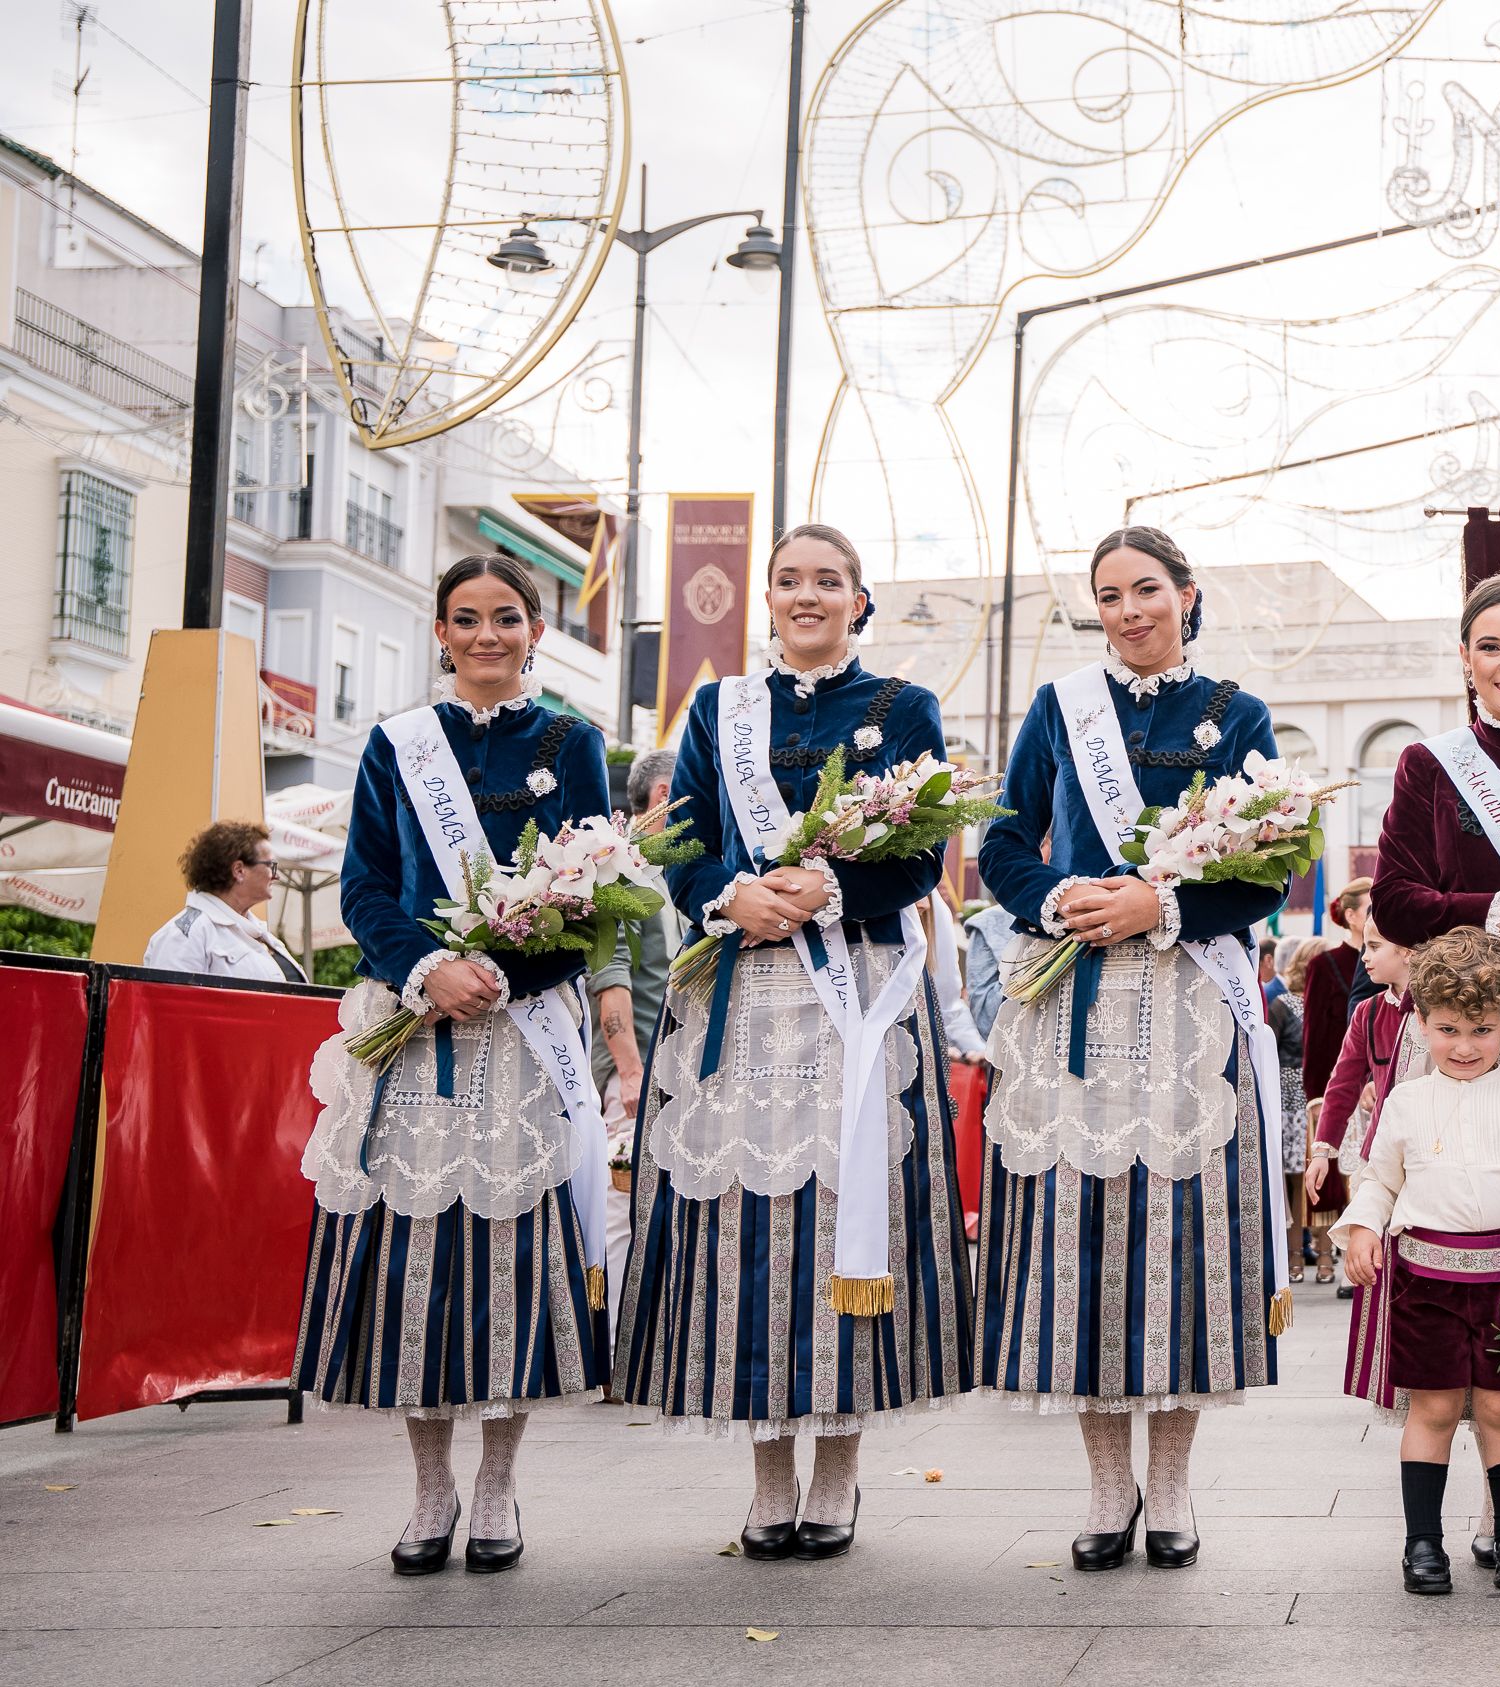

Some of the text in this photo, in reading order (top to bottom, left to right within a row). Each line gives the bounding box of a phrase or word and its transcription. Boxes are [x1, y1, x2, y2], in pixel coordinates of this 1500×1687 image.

[734, 722, 756, 786] DAMA
[1086, 737, 1122, 806] DAMA
[45, 775, 121, 824] Cruzcamp
[423, 776, 468, 849] DAMA
[1228, 976, 1257, 1020] 2026
[550, 1044, 582, 1091] 2026
